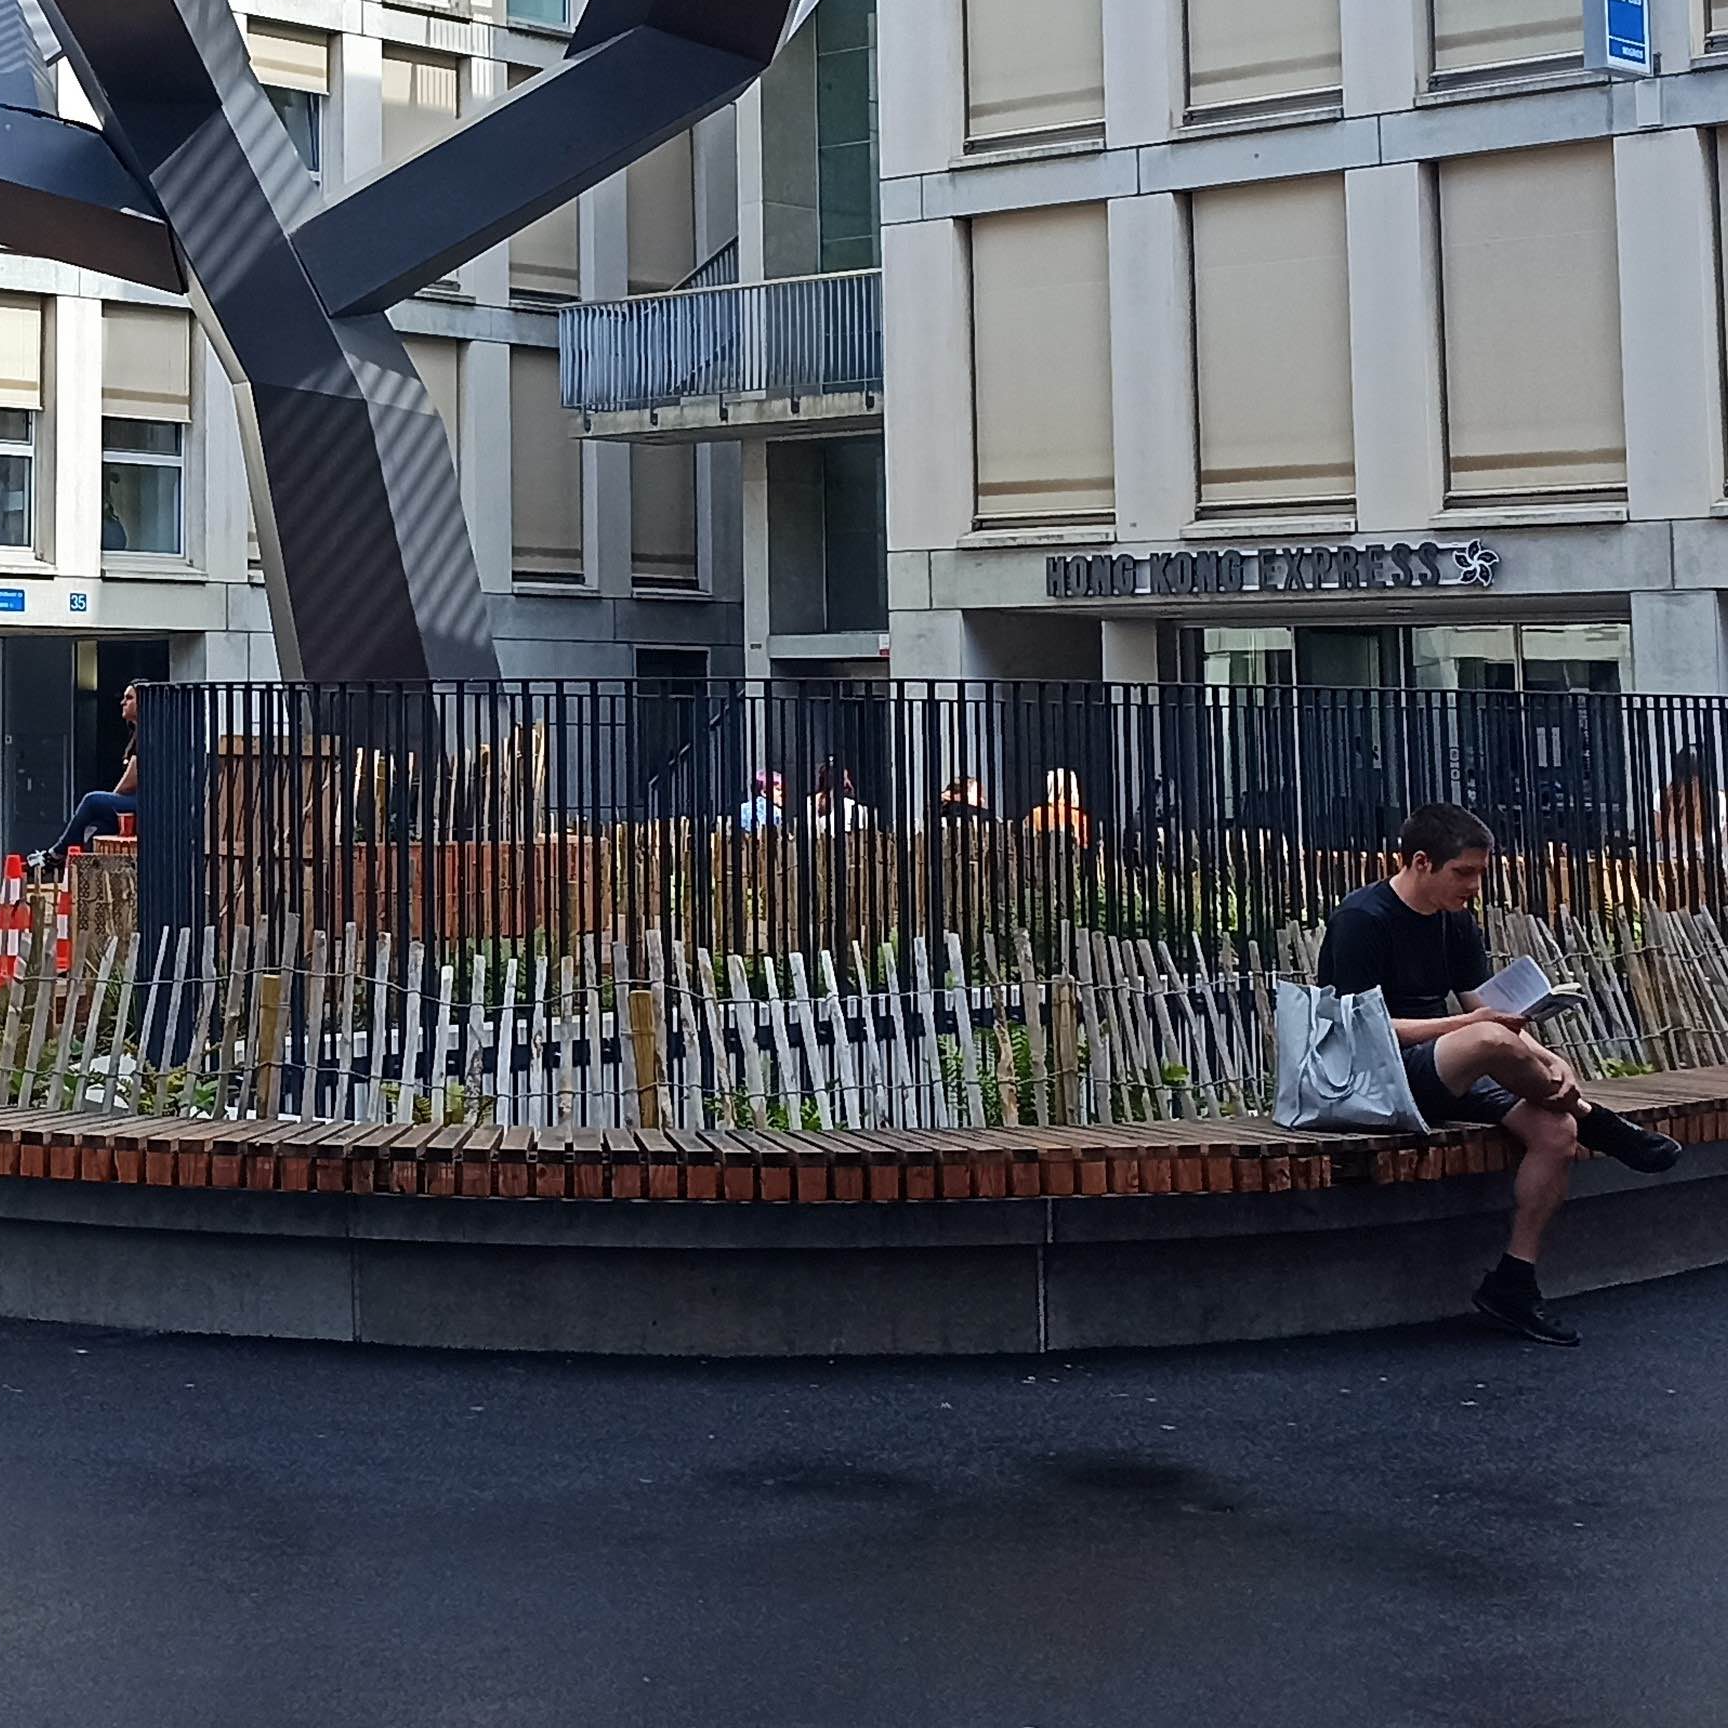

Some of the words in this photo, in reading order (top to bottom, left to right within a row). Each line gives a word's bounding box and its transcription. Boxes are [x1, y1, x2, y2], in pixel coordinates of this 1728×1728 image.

[1046, 554, 1136, 597] HONG
[1150, 549, 1244, 594] KONG
[1258, 541, 1441, 592] EXPRESS
[70, 594, 87, 610] 35
